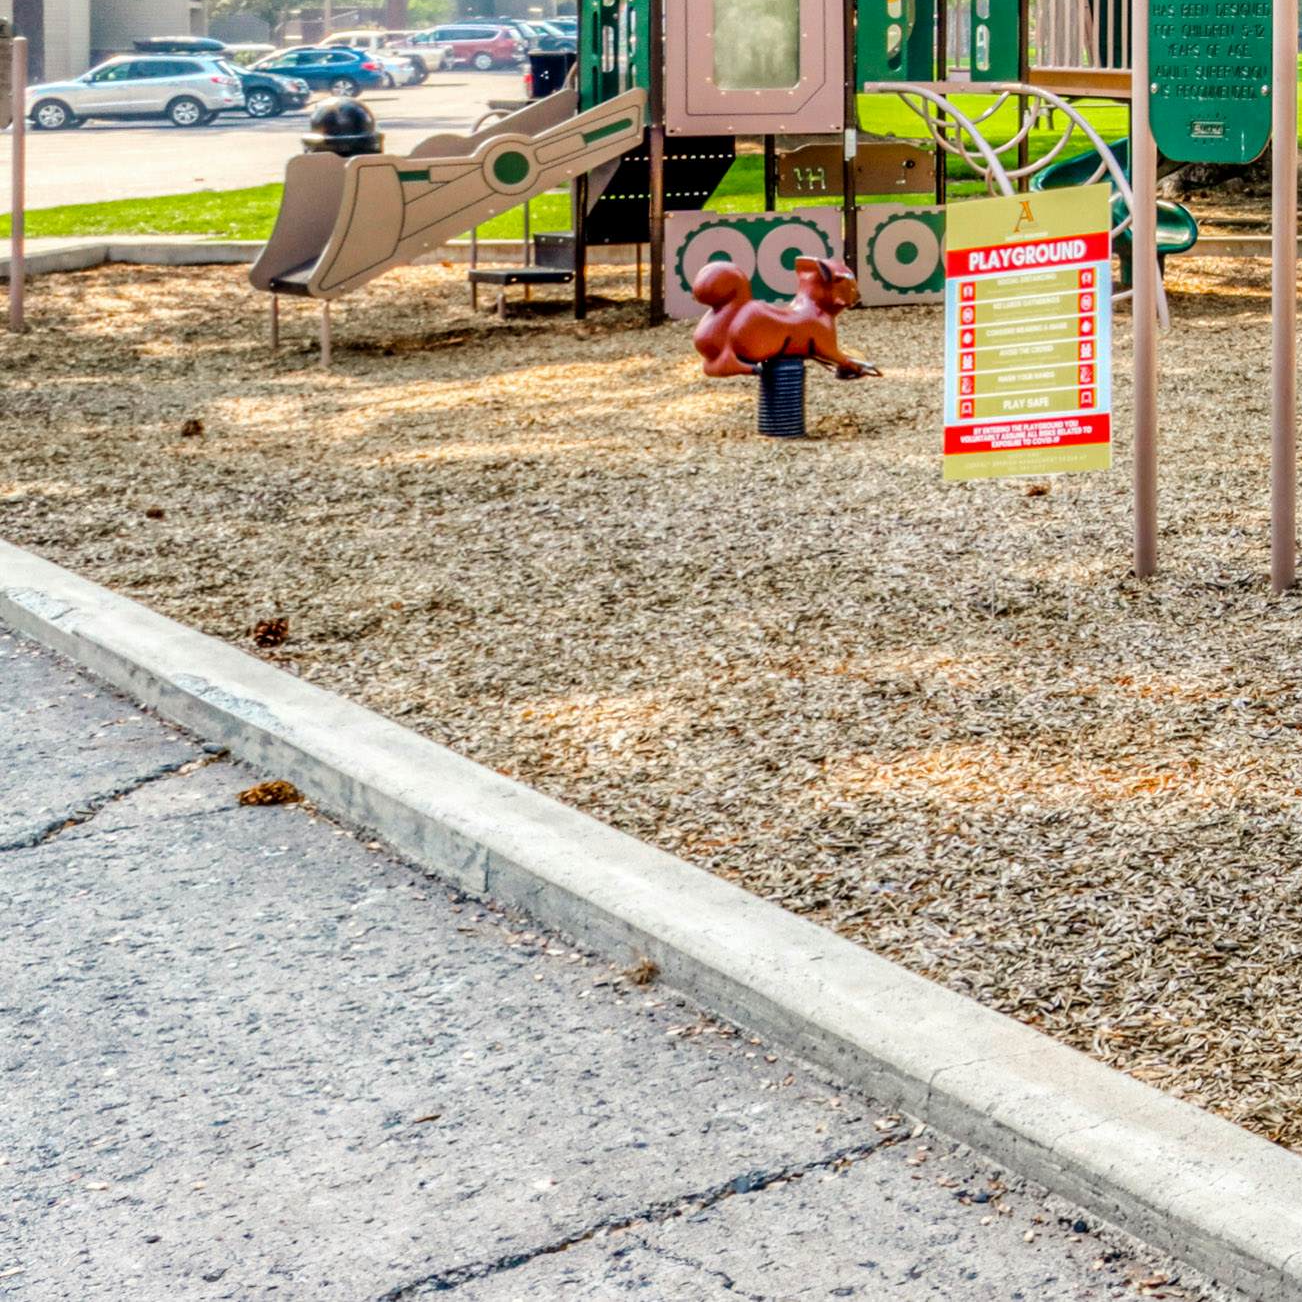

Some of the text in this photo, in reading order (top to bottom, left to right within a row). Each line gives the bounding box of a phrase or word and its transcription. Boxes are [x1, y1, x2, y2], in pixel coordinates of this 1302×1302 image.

[1152, 2, 1270, 18] HAS BEEN DESIGNED
[1154, 23, 1265, 39] FOR CHILDREN 5-12
[1168, 43, 1201, 59] YEARS
[1207, 43, 1221, 59] OF
[1155, 65, 1267, 81] ADULT SUPERVISION
[1160, 84, 1170, 99] IS
[1013, 201, 1034, 233] A
[969, 239, 1087, 272] PLAYGROUND
[1003, 396, 1050, 410] PLAY SAFE
[960, 426, 1092, 444] VOLUNTARILY ASSUME ALL RISKS RELATED TO
[973, 419, 1079, 435] BY ENTERING THE PLAYGROUND YOU
[991, 439, 1022, 449] EXPOSURE
[1023, 437, 1031, 446] TO
